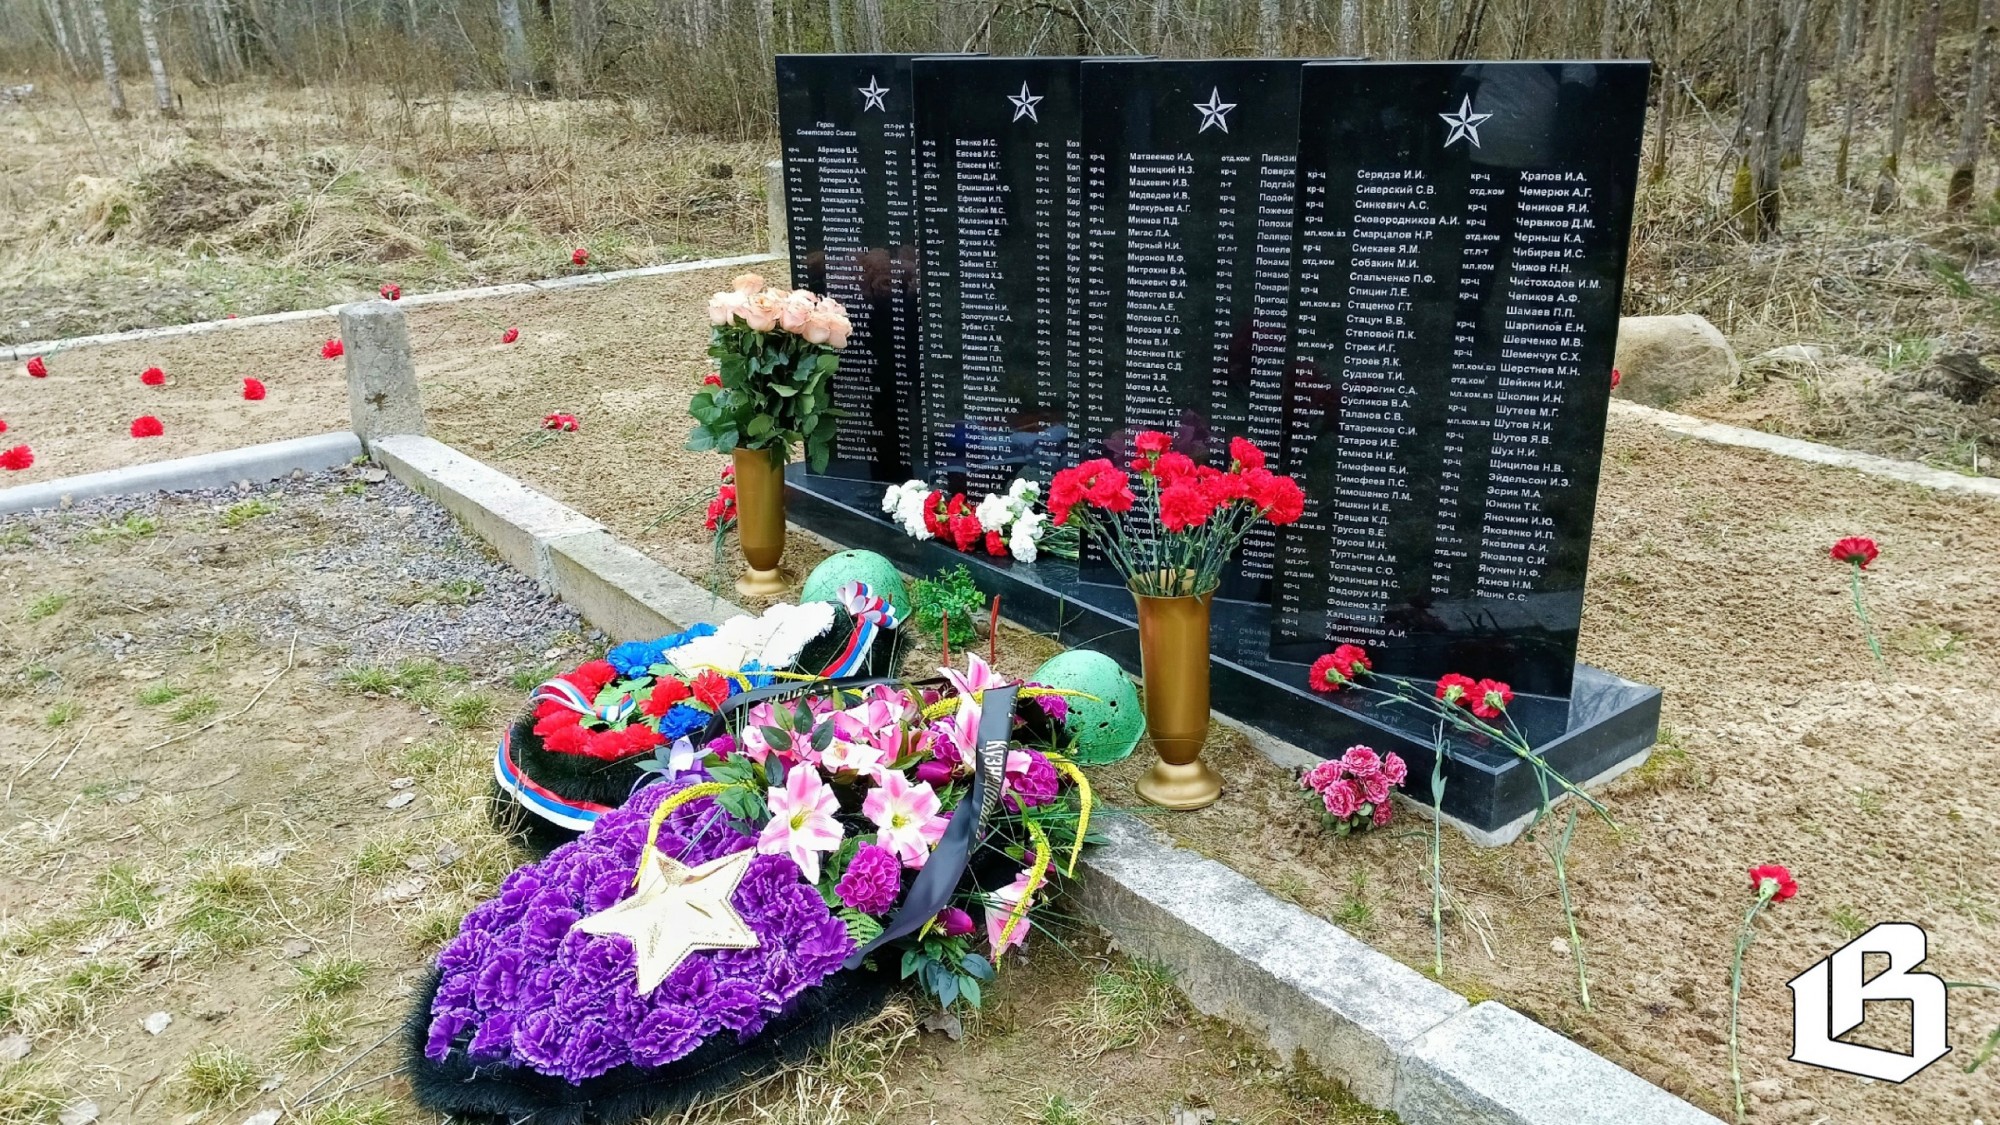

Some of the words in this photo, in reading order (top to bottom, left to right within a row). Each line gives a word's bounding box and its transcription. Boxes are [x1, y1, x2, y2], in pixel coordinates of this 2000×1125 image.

[1307, 171, 1326, 180] кр-ц
[1357, 169, 1401, 181] Серядзе
[1403, 169, 1425, 180] И.И.
[1470, 173, 1491, 182] кр-ц
[1520, 170, 1562, 183] Храпов
[1564, 171, 1588, 182] И.А.
[1306, 185, 1326, 195] кр-ц
[1355, 184, 1413, 196] Сиверский
[1415, 184, 1437, 195] С.В.
[1519, 185, 1570, 198] Чемерюк
[1571, 187, 1592, 198] А.Г.
[1305, 201, 1324, 210] кр-ц
[1354, 199, 1406, 210] Синкевич
[1407, 200, 1430, 210] А.С.
[1467, 203, 1488, 213] кр-ц
[1566, 203, 1590, 213] Я.И.
[1305, 215, 1323, 225] кр-ц
[1353, 214, 1436, 226] Сковородников
[1438, 215, 1461, 226] А.И.
[1466, 219, 1487, 227] кр-ц
[1515, 216, 1570, 229] Червяков
[1569, 218, 1596, 230] Д.М.
[1352, 228, 1412, 240] Смарцалов
[1414, 230, 1434, 240] Н.Р.
[1514, 231, 1561, 244] Черныш
[1563, 233, 1585, 244] К.А.
[1512, 246, 1561, 260] Чибирев
[1563, 248, 1586, 259] И.С.
[1350, 257, 1395, 268] Собакин
[1396, 258, 1420, 269] М.И.
[1511, 261, 1547, 273] Чижов
[1549, 263, 1572, 274] Н.Н.
[1301, 272, 1320, 281] кр-ц
[1349, 271, 1411, 283] Спальченко
[1412, 273, 1436, 284] П.Ф.
[1460, 278, 1480, 286] кр-ц
[1509, 276, 1575, 289] Чистоходов
[1578, 279, 1602, 289] И.М.
[1300, 286, 1319, 295] кр-ц
[1348, 286, 1388, 297] Спицин
[1389, 287, 1410, 297] Л.Е.
[1459, 292, 1479, 301] кр-ц
[1556, 293, 1581, 304] А.Ф.
[1397, 301, 1414, 312] Г.Т.
[1506, 305, 1551, 317] Шамаев
[1553, 307, 1576, 318] П.П.
[1298, 314, 1317, 323] кр-ц
[1346, 313, 1383, 326] Стацун
[1385, 315, 1406, 326] В.В.
[1297, 326, 1316, 336] кр-ц
[1345, 328, 1395, 339] Степовой
[1396, 330, 1417, 340] П.К.
[1455, 334, 1475, 344] кр-ц
[1503, 334, 1558, 346] Шевченко
[1560, 337, 1584, 348] М.В.
[1295, 368, 1313, 377] кр-ц
[1342, 368, 1385, 380] Судаков
[1387, 371, 1405, 381] Т.И.
[1339, 408, 1382, 420] Таланов
[1383, 411, 1404, 422] С.В.
[1448, 404, 1467, 413] кр-ц
[1539, 407, 1559, 418] М.Г.
[1494, 418, 1530, 430] Шутов
[1531, 421, 1554, 431] Н.И.
[1337, 434, 1378, 447] Татаров
[1379, 438, 1400, 448] И.Е.
[1445, 431, 1465, 440] кр-ц
[1492, 431, 1528, 443] Шутов
[1529, 434, 1552, 445] Я.В.
[1290, 446, 1308, 455] кр-ц
[1336, 447, 1374, 459] Темнов
[1375, 450, 1396, 461] Н.И.
[1443, 445, 1463, 453] кр-ц
[1490, 445, 1515, 457] Шух
[1516, 447, 1538, 458] Н.И.
[1442, 471, 1461, 481] кр-ц
[1488, 472, 1547, 486] Эйдельсон
[1549, 477, 1574, 488] И.Э.
[1440, 484, 1459, 493] кр-ц
[1520, 488, 1544, 499] М.А.
[1439, 497, 1458, 506] кр-ц
[1485, 498, 1521, 510] Юнкин
[1523, 502, 1541, 512] Т.К.
[1436, 523, 1456, 531] кр-ц
[1482, 525, 1532, 538] Яковенко
[1534, 529, 1556, 540] И.П.
[1479, 551, 1524, 563] Яковлев
[1526, 555, 1548, 566] С.И.
[1432, 574, 1451, 582] кр-ц
[1477, 576, 1510, 588] Яхнов
[1512, 579, 1534, 590] Н.М.
[1283, 582, 1300, 590] кр-ц
[1328, 585, 1370, 598] Федорук
[1371, 590, 1391, 600] И.В.
